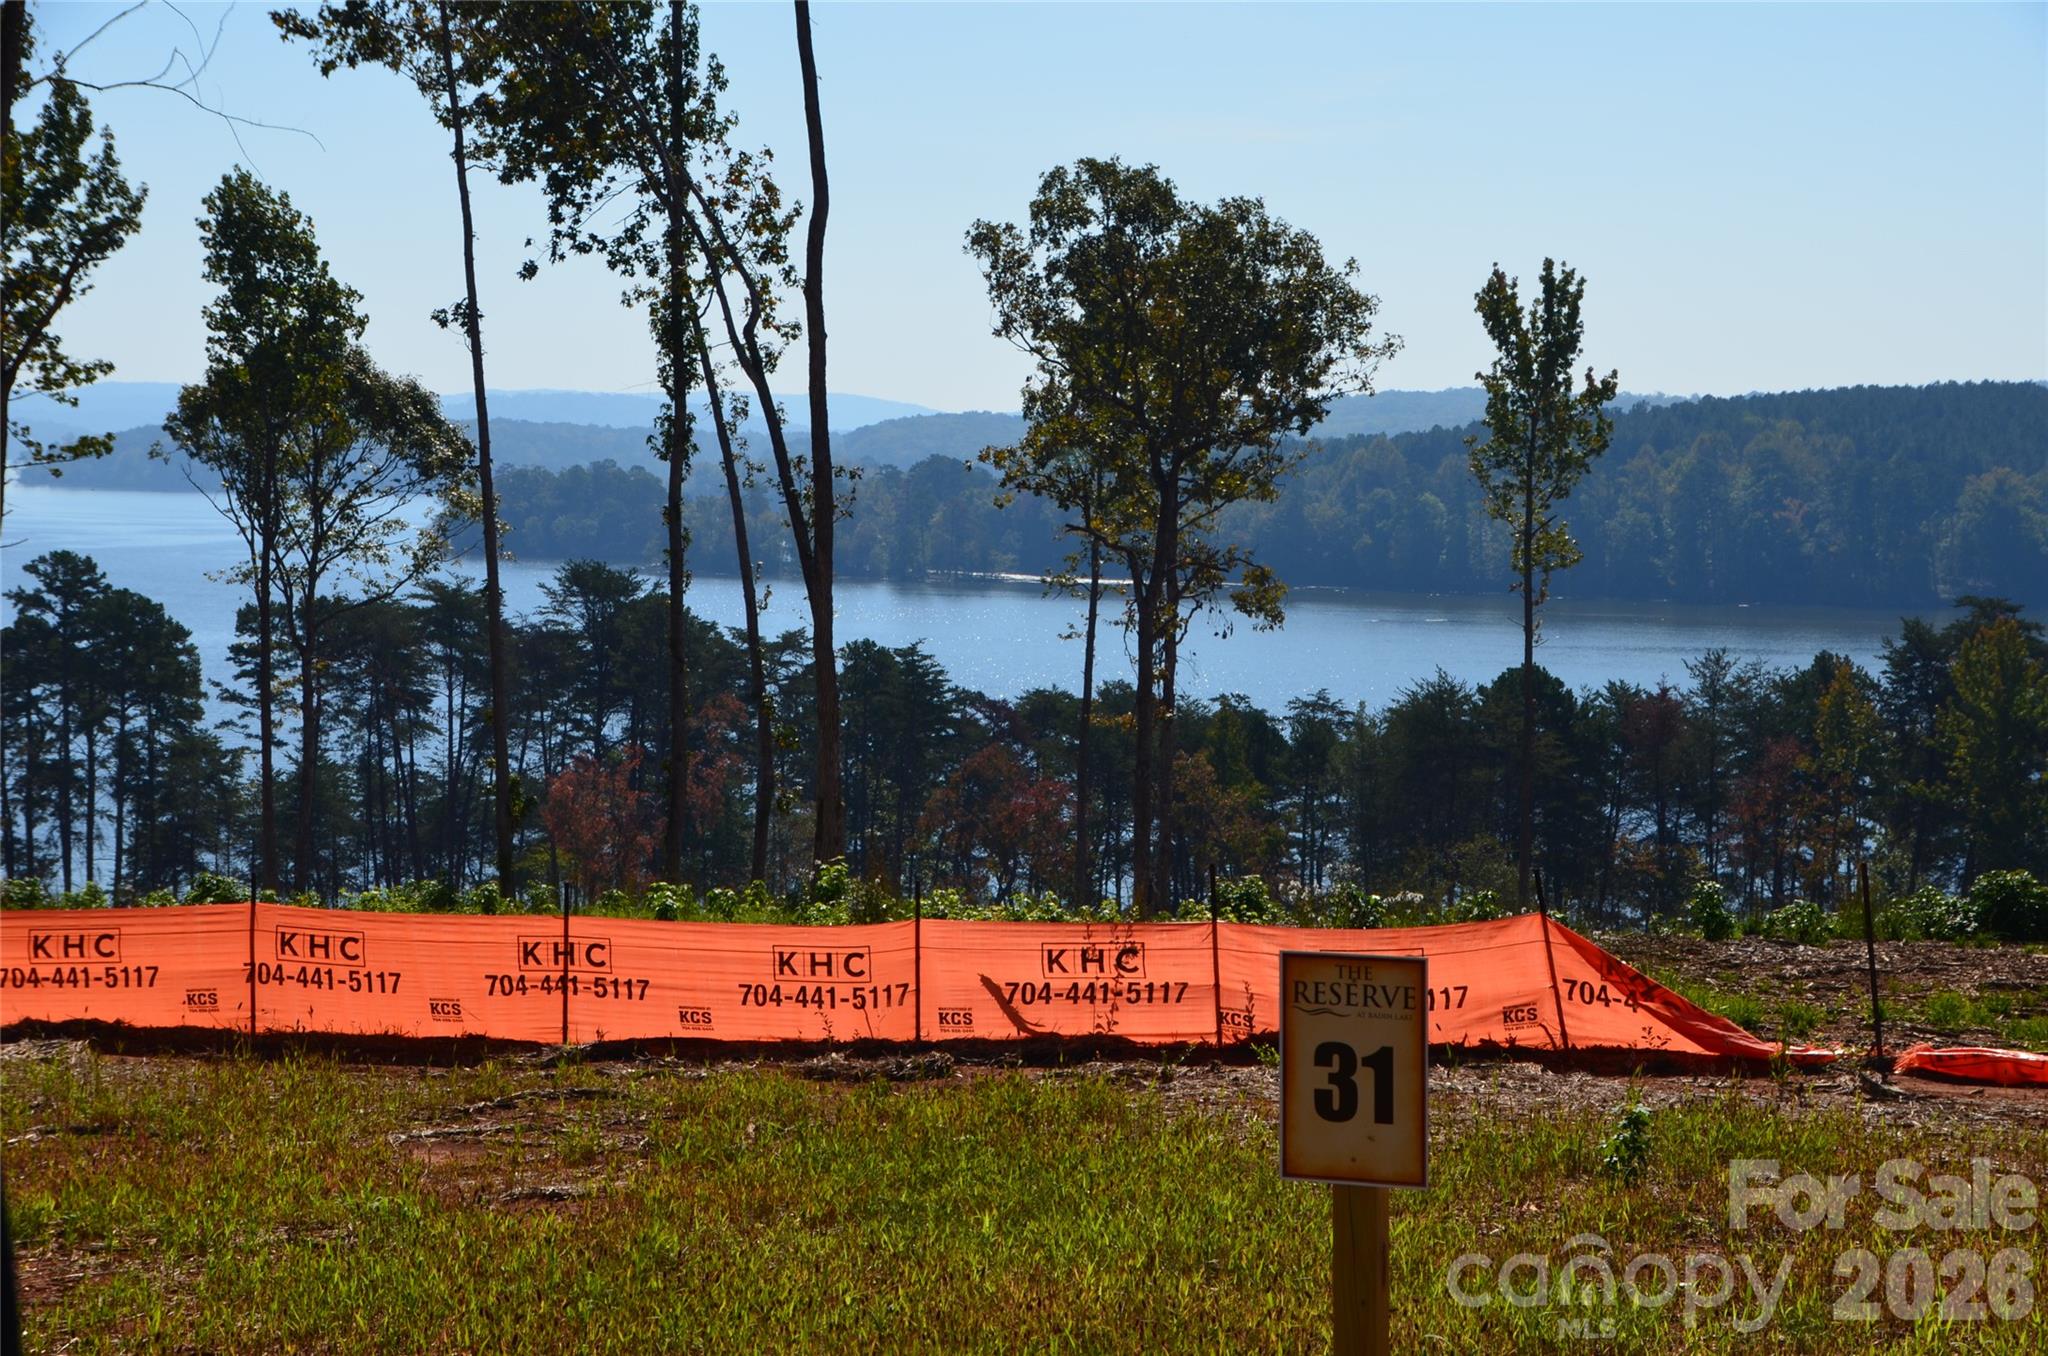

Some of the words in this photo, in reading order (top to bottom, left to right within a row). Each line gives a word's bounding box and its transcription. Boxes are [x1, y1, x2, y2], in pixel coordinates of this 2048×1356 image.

[0, 966, 159, 989] 704-441-5117
[242, 962, 402, 994] 704-441-5117
[1335, 964, 1374, 981] THE
[186, 992, 218, 1006] KCS
[484, 974, 650, 1001] 704-441-5117
[738, 983, 910, 1010] 704-441-5117
[1004, 981, 1189, 1005] 704-441-5117
[1293, 979, 1418, 1011] RESERVE
[429, 1002, 462, 1016] KCS
[679, 1010, 713, 1024] KCS
[938, 1012, 973, 1025] KCS
[1503, 1007, 1538, 1024] KCS
[1313, 1041, 1394, 1125] 31
